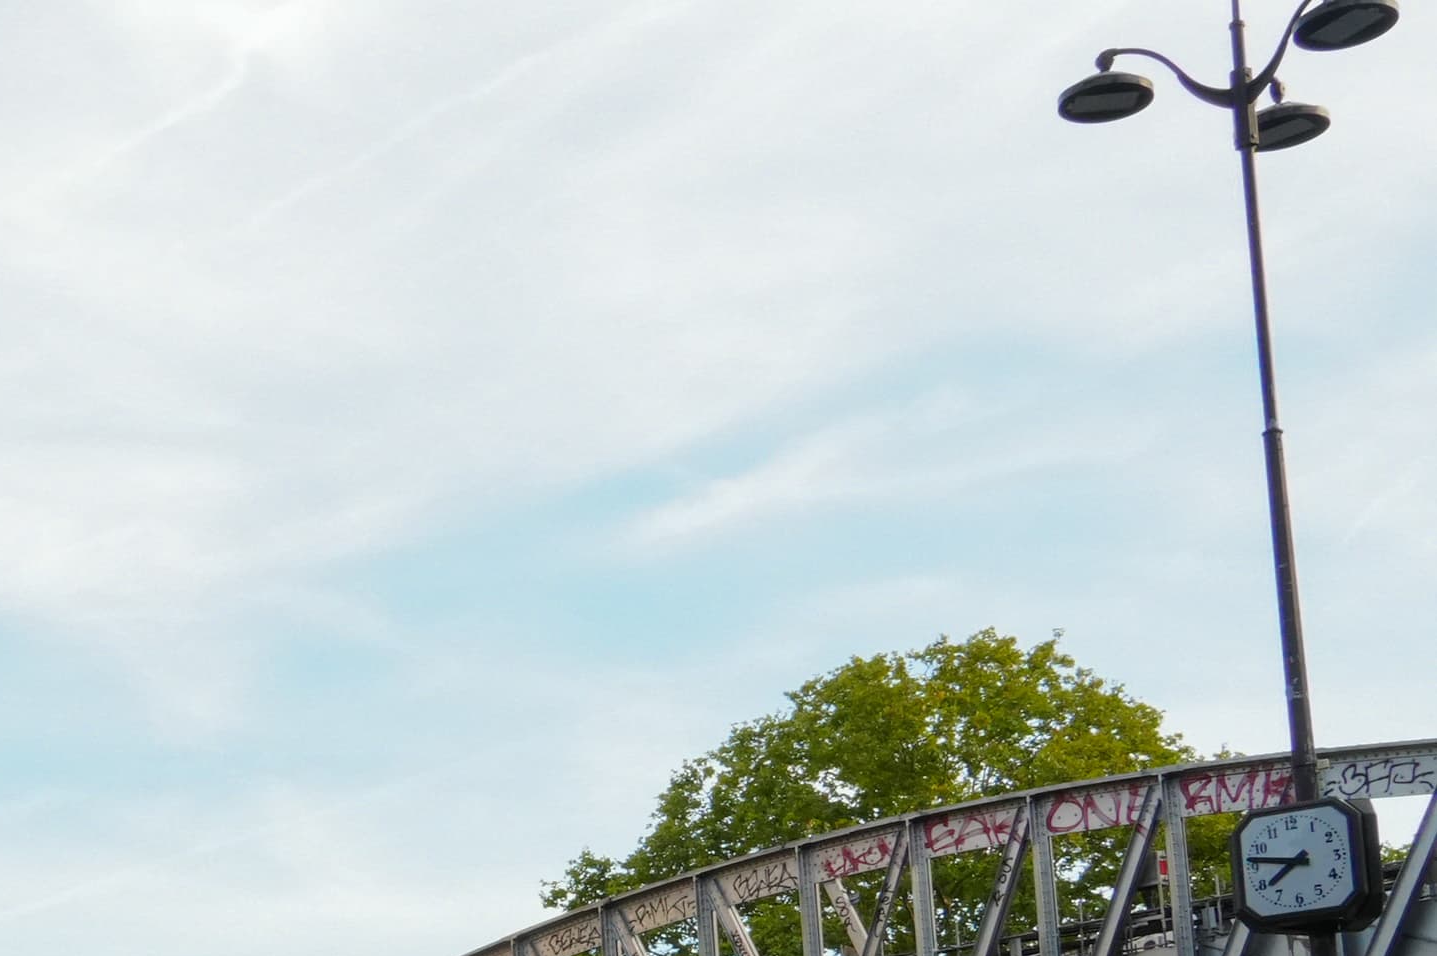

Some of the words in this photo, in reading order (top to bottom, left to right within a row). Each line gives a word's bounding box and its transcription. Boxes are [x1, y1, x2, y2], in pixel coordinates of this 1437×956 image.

[1285, 818, 1297, 831] 12
[1310, 821, 1315, 832] 1
[1267, 828, 1278, 839] 11
[1325, 832, 1333, 843] 2
[1255, 842, 1267, 854] 10
[1333, 849, 1341, 861] 3
[1251, 861, 1259, 873] 9
[1328, 868, 1338, 879] 4
[1259, 880, 1267, 890] 8
[1314, 884, 1323, 895] 5
[1275, 890, 1283, 901] 7
[1295, 892, 1304, 904] 6
